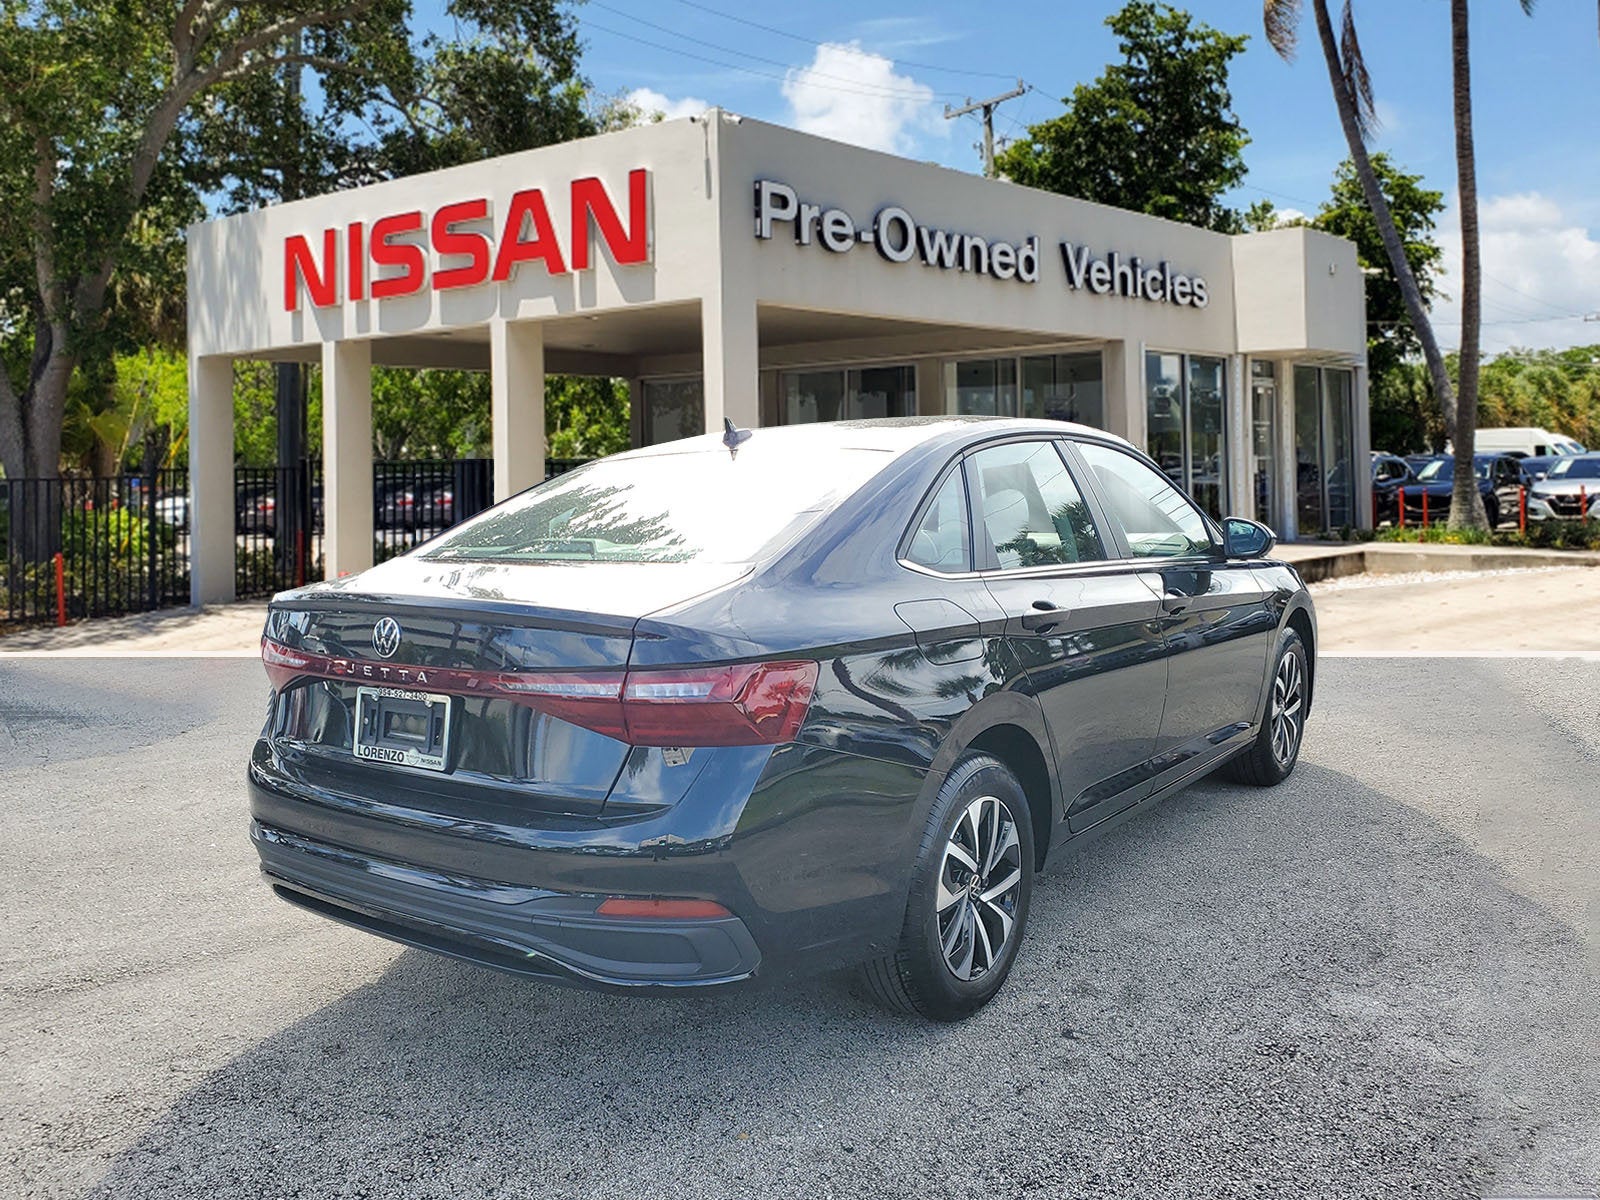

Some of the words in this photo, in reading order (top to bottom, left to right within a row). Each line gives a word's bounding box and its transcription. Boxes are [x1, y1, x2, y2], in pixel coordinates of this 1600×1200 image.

[284, 168, 648, 312] NISSAN
[754, 179, 1040, 283] Pre-Owned
[1060, 241, 1209, 309] Vehicles
[346, 663, 428, 684] JETTA
[357, 745, 405, 763] LORENZO
[420, 757, 442, 767] NISSAN
